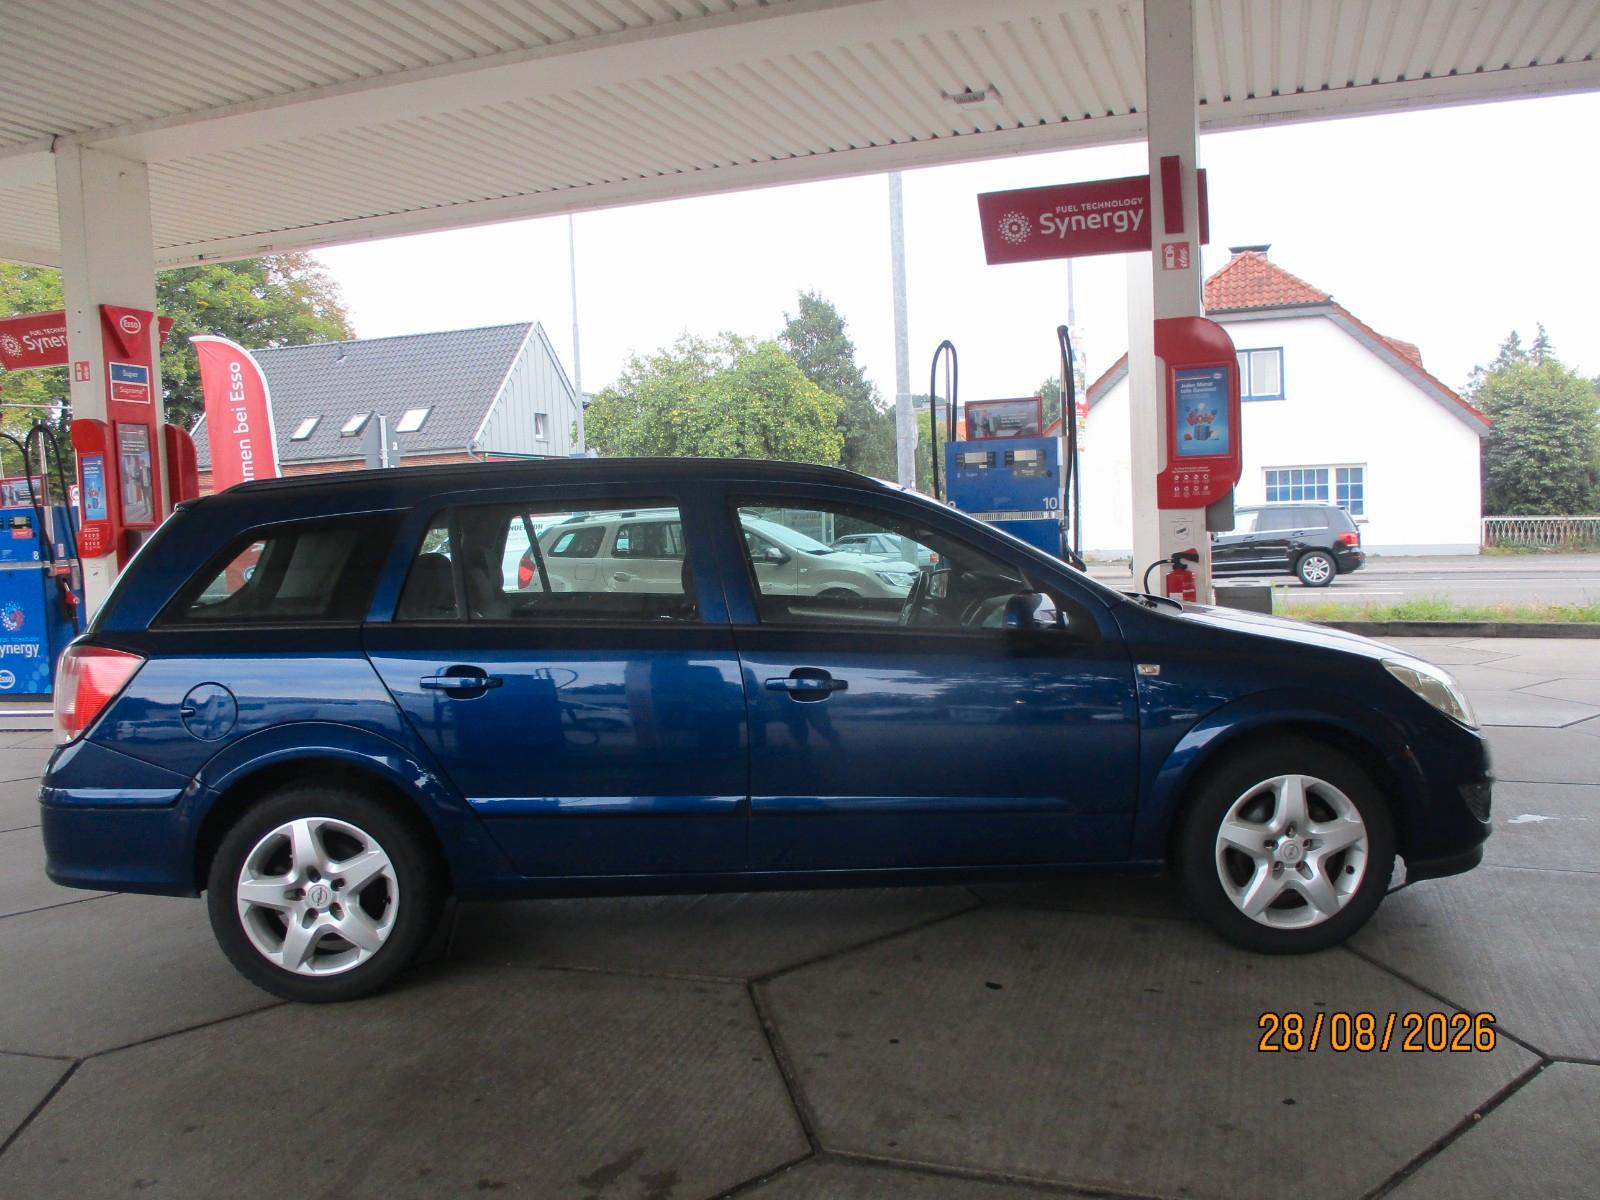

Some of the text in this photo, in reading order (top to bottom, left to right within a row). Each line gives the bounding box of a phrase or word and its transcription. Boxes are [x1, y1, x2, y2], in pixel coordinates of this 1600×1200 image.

[1056, 197, 1143, 214] FUEL TECHNOLOGY
[1039, 208, 1144, 239] Synergy
[22, 335, 67, 354] Syner
[229, 361, 245, 401] Esso
[231, 407, 249, 433] bei
[1042, 497, 1058, 510] 10
[32, 550, 40, 560] 8
[0, 643, 39, 658] ynergy
